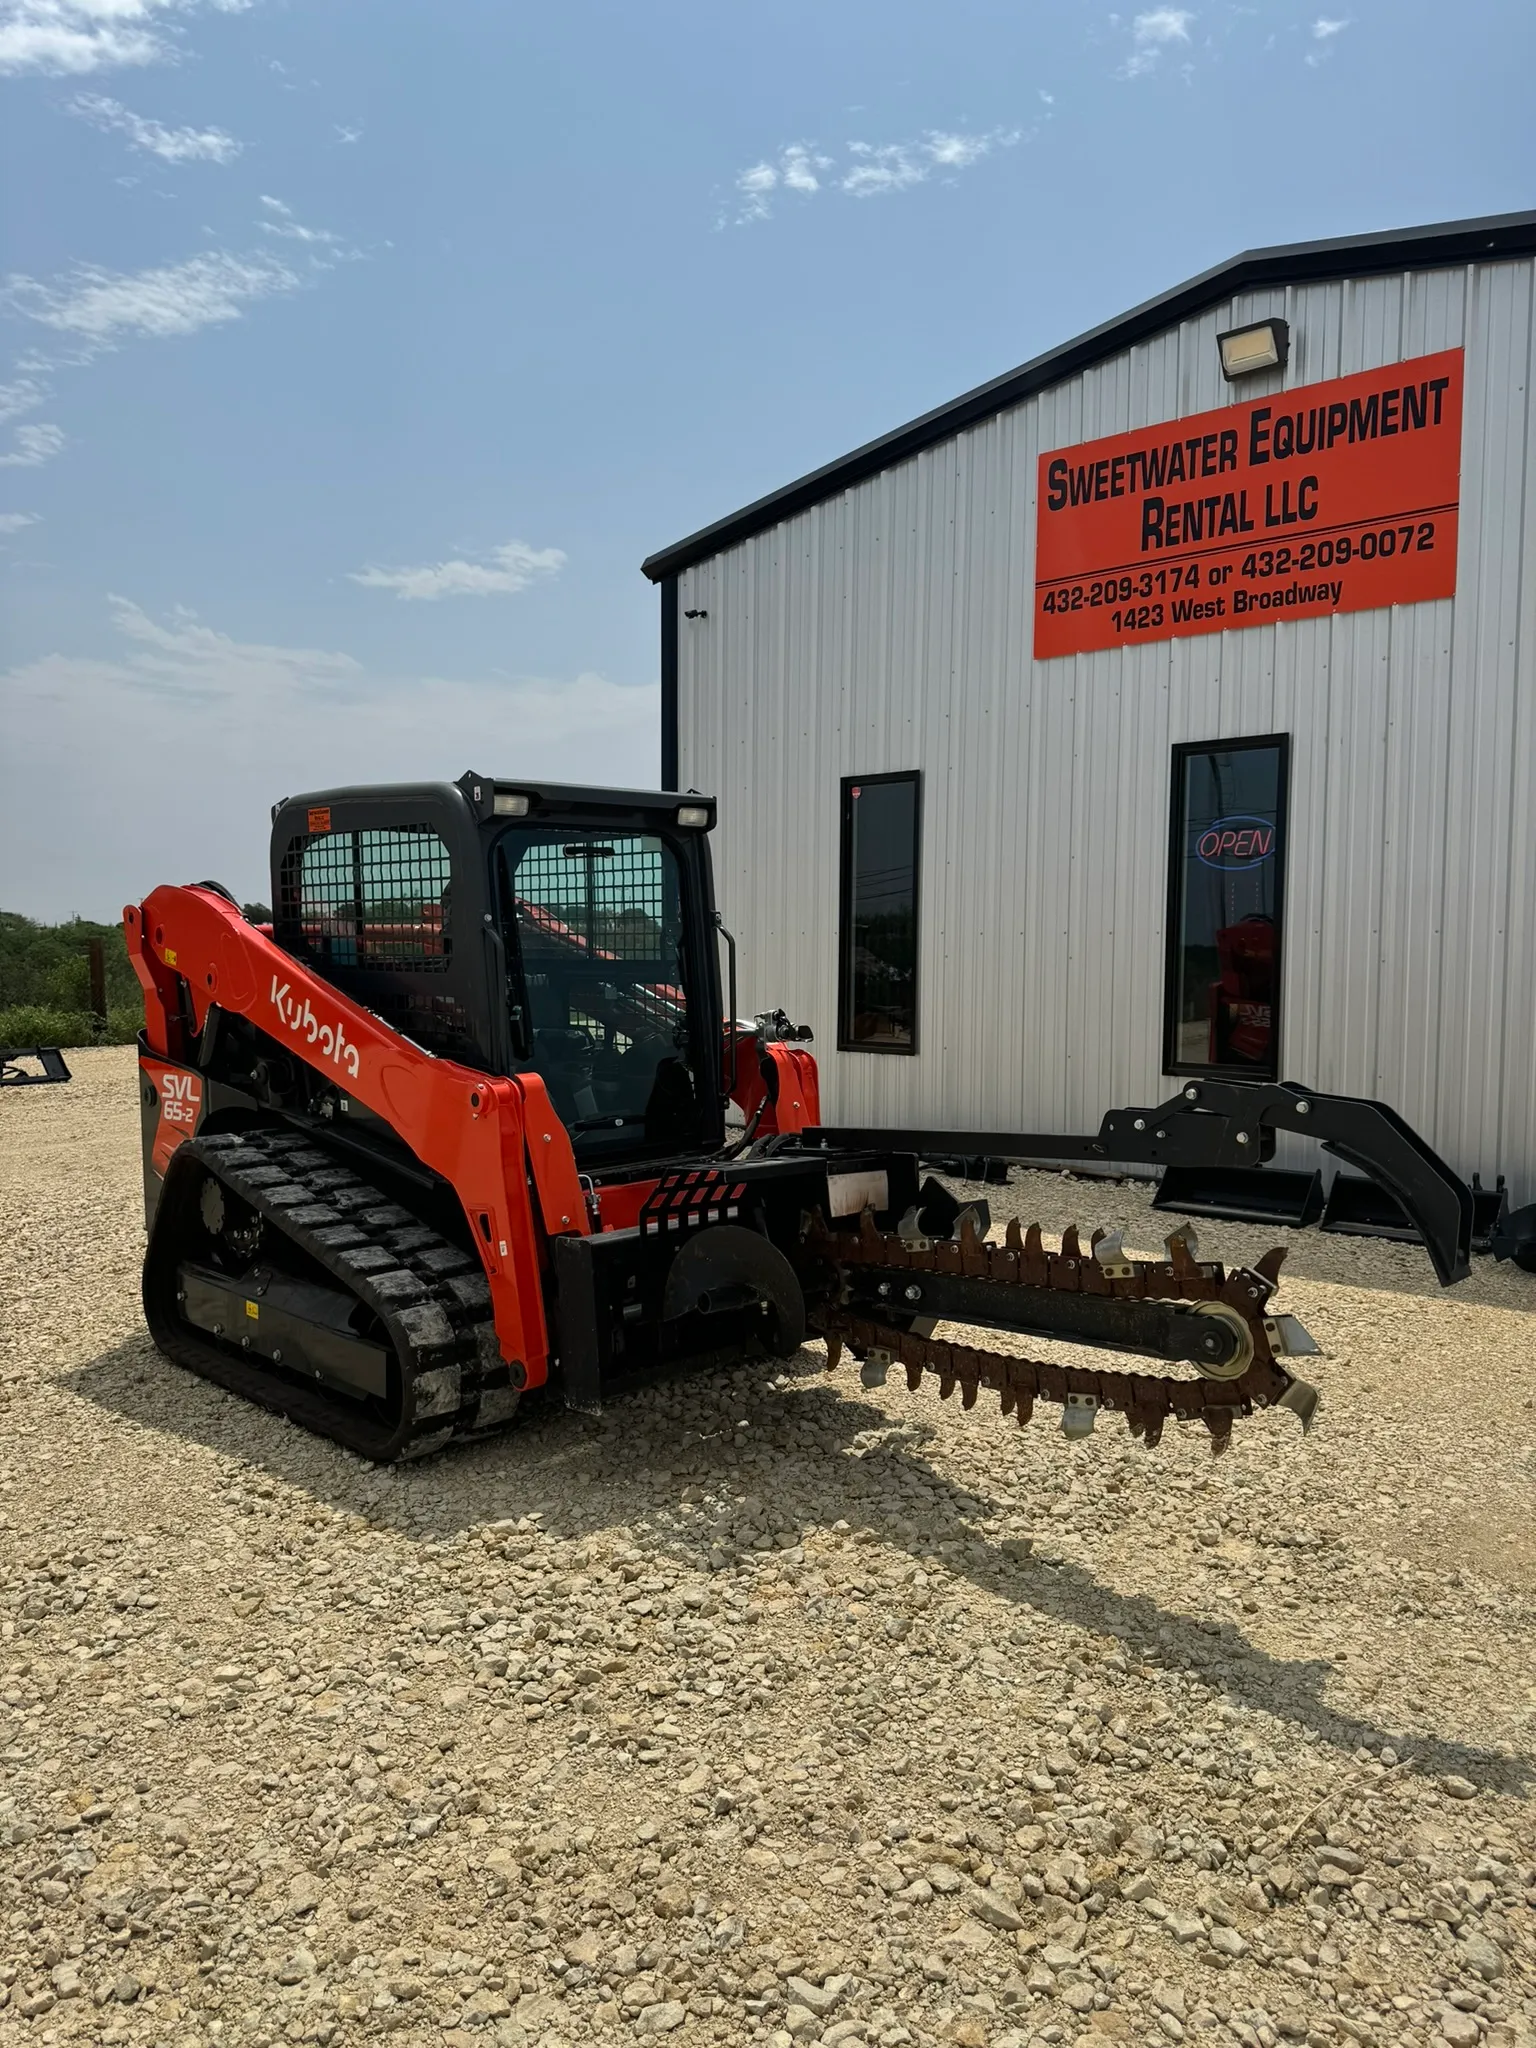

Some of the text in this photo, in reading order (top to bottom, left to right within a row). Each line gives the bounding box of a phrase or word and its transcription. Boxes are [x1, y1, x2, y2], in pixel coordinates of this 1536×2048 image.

[1047, 377, 1449, 512] SWEETWATER EQUIPMENT
[1141, 475, 1319, 552] RENTAL LLC
[1043, 523, 1435, 615] 432-209-3174 or 432-209-0072
[1111, 581, 1343, 633] 1423 West Broadway
[1200, 830, 1271, 856] OPEN
[271, 974, 360, 1079] Kubota
[161, 1074, 200, 1102] SVL
[164, 1100, 194, 1123] 65-2
